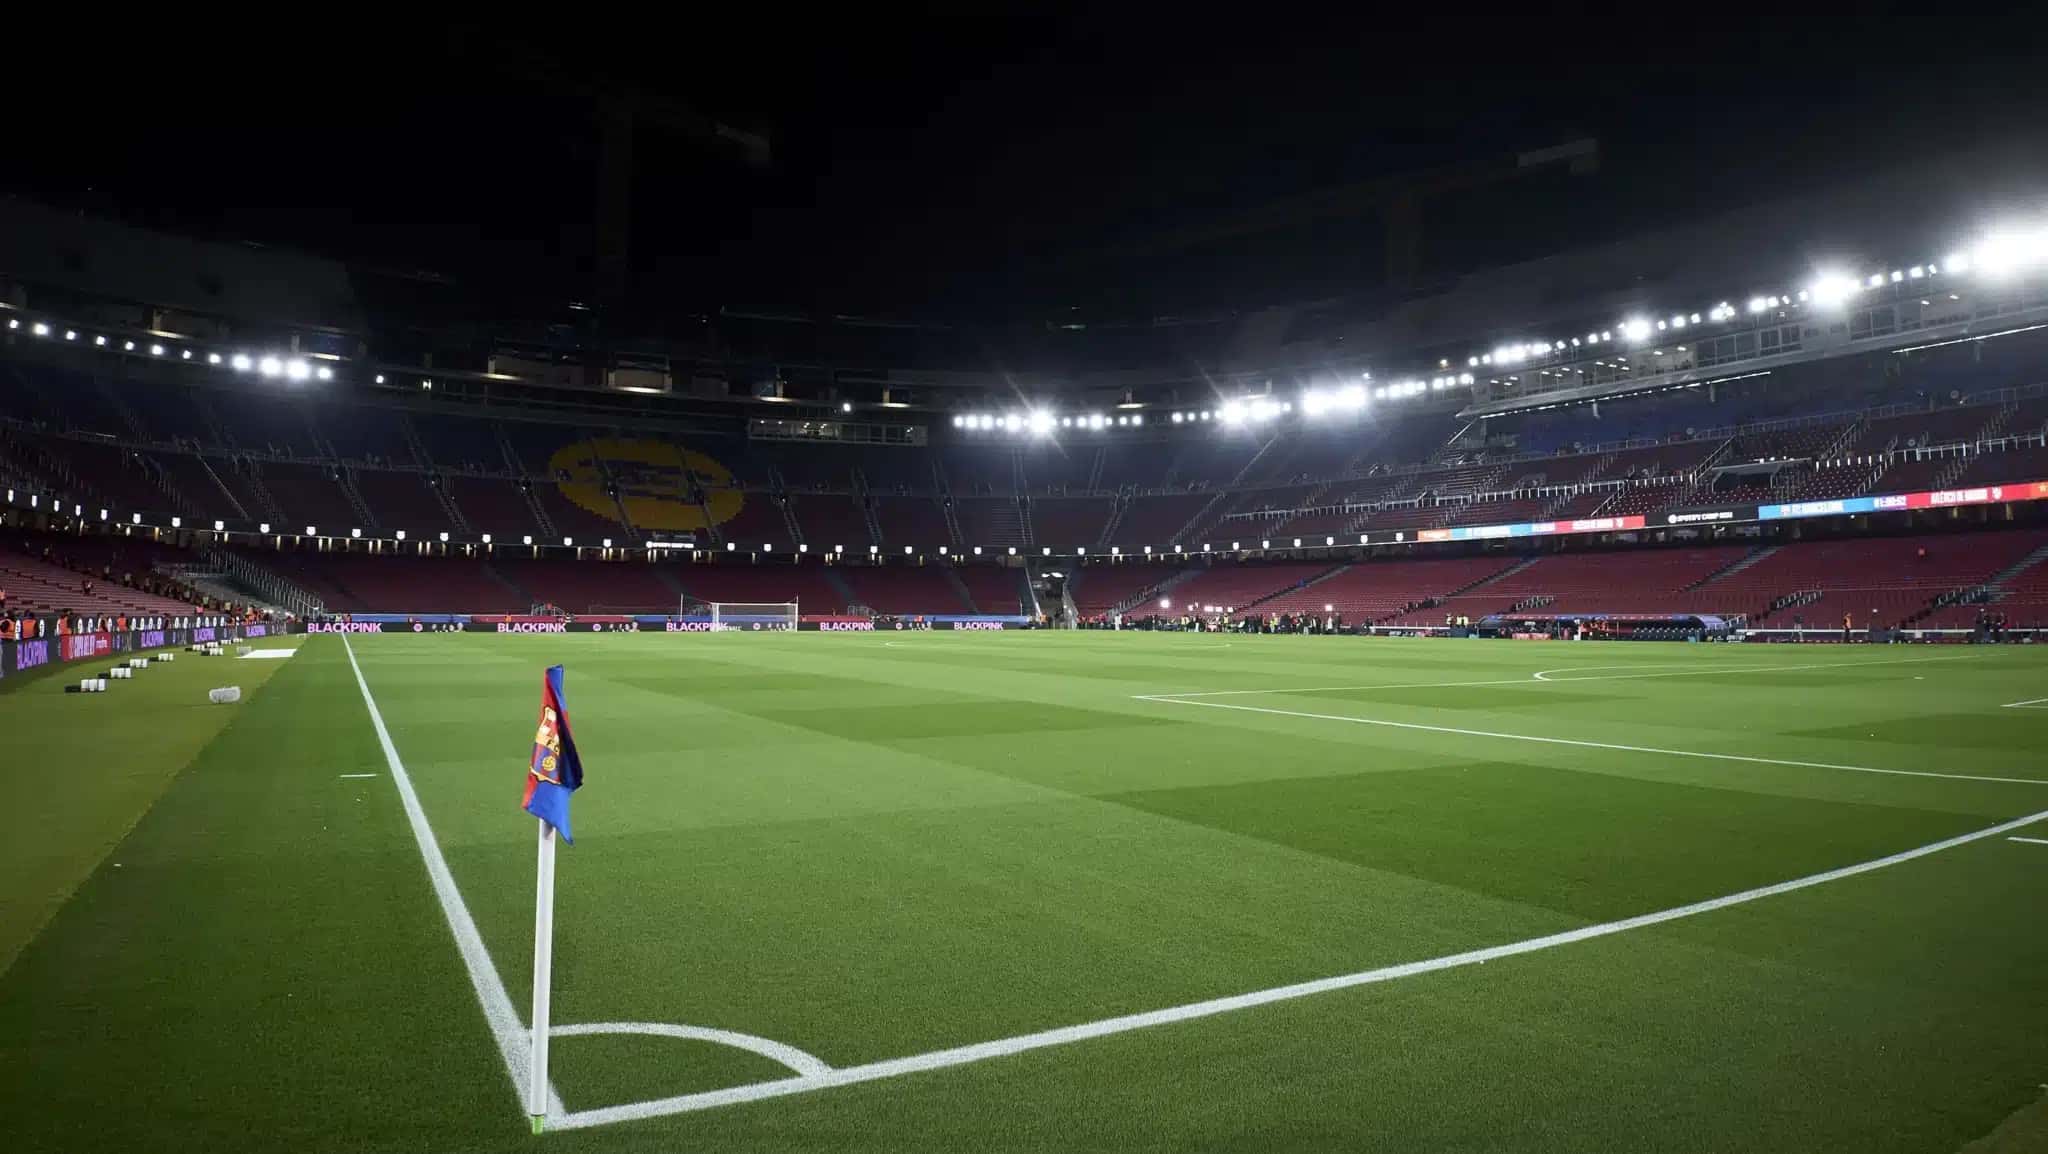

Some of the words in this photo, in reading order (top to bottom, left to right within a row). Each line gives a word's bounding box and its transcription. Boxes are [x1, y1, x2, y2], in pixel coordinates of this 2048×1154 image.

[307, 622, 383, 633] BLACKPINK
[497, 622, 567, 632] BLACKPINK
[820, 622, 875, 632] BLACKPINK
[954, 621, 1004, 631] BLACKPINK
